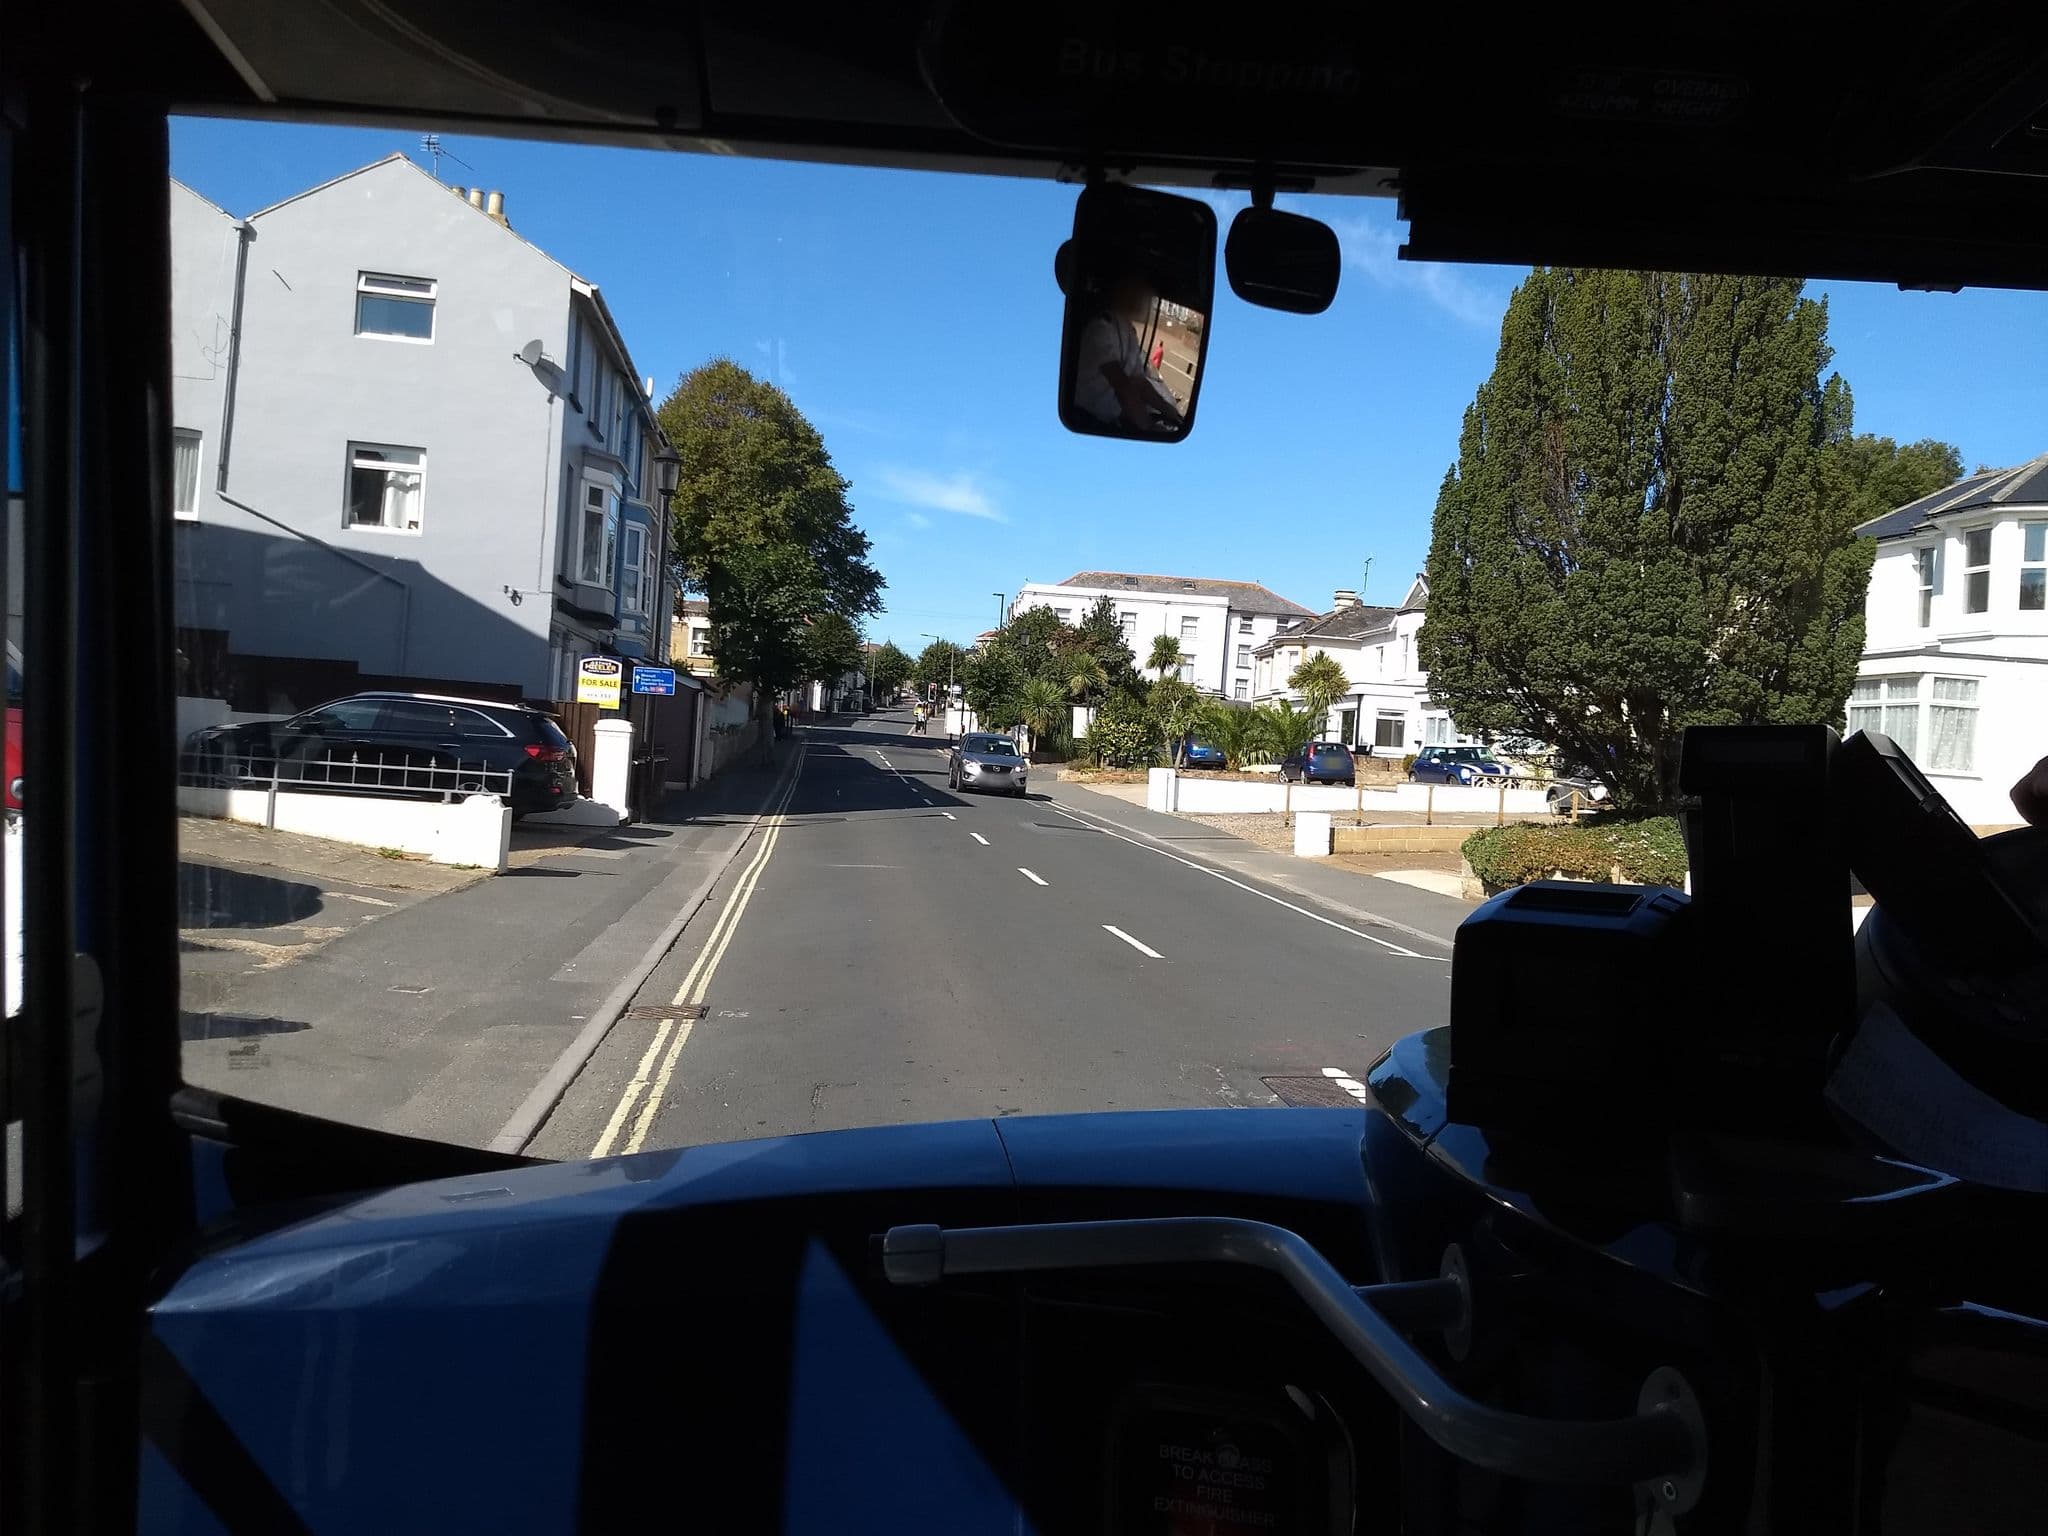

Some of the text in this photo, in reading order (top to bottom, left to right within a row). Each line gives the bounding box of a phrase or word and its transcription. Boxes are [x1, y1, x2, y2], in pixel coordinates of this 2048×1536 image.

[1060, 38, 1144, 77] Bus
[582, 678, 617, 688] FOR SALE
[1160, 1445, 1214, 1464] BREAK
[1174, 1464, 1265, 1489] TO ACCESS
[1196, 1486, 1233, 1504] FIRE
